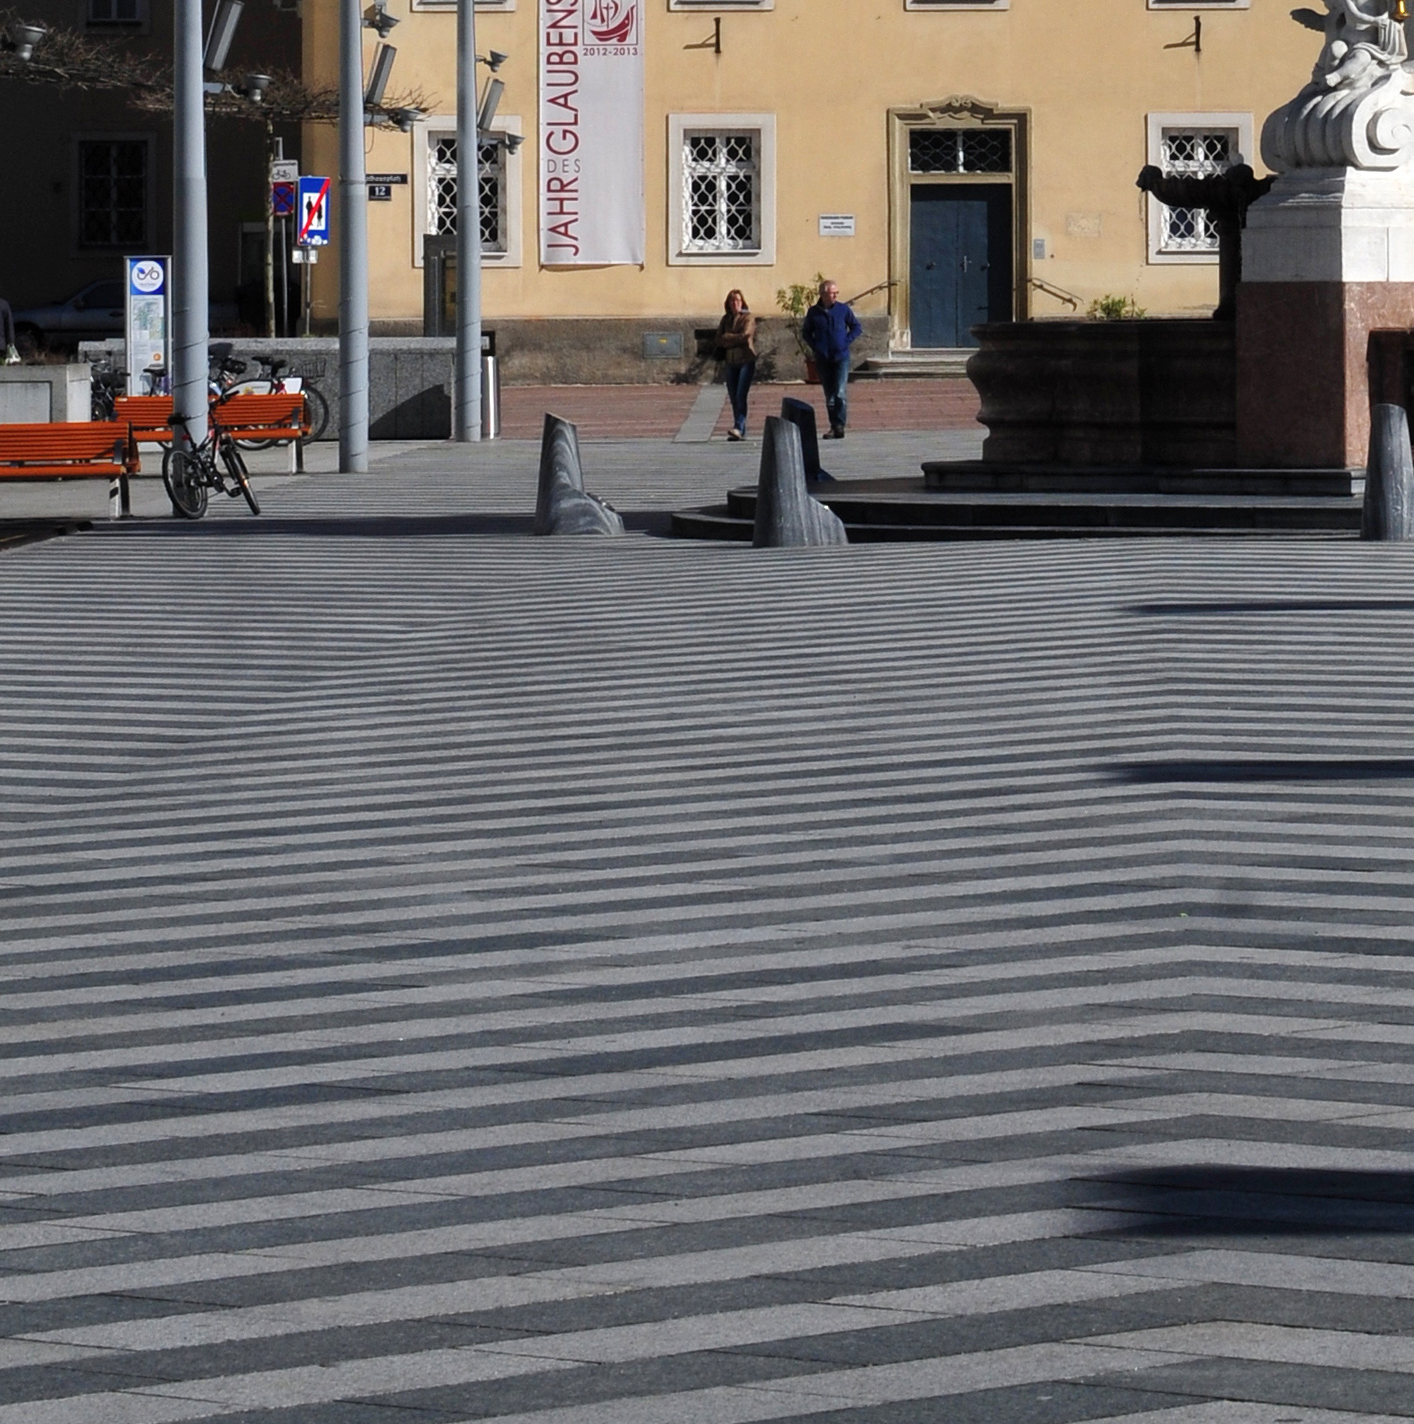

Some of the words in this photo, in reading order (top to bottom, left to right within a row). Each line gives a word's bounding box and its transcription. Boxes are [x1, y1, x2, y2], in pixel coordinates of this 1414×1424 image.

[583, 47, 638, 56] 2012-2013
[547, 159, 581, 173] DES
[375, 186, 386, 196] 12
[546, 177, 579, 256] JAHR
